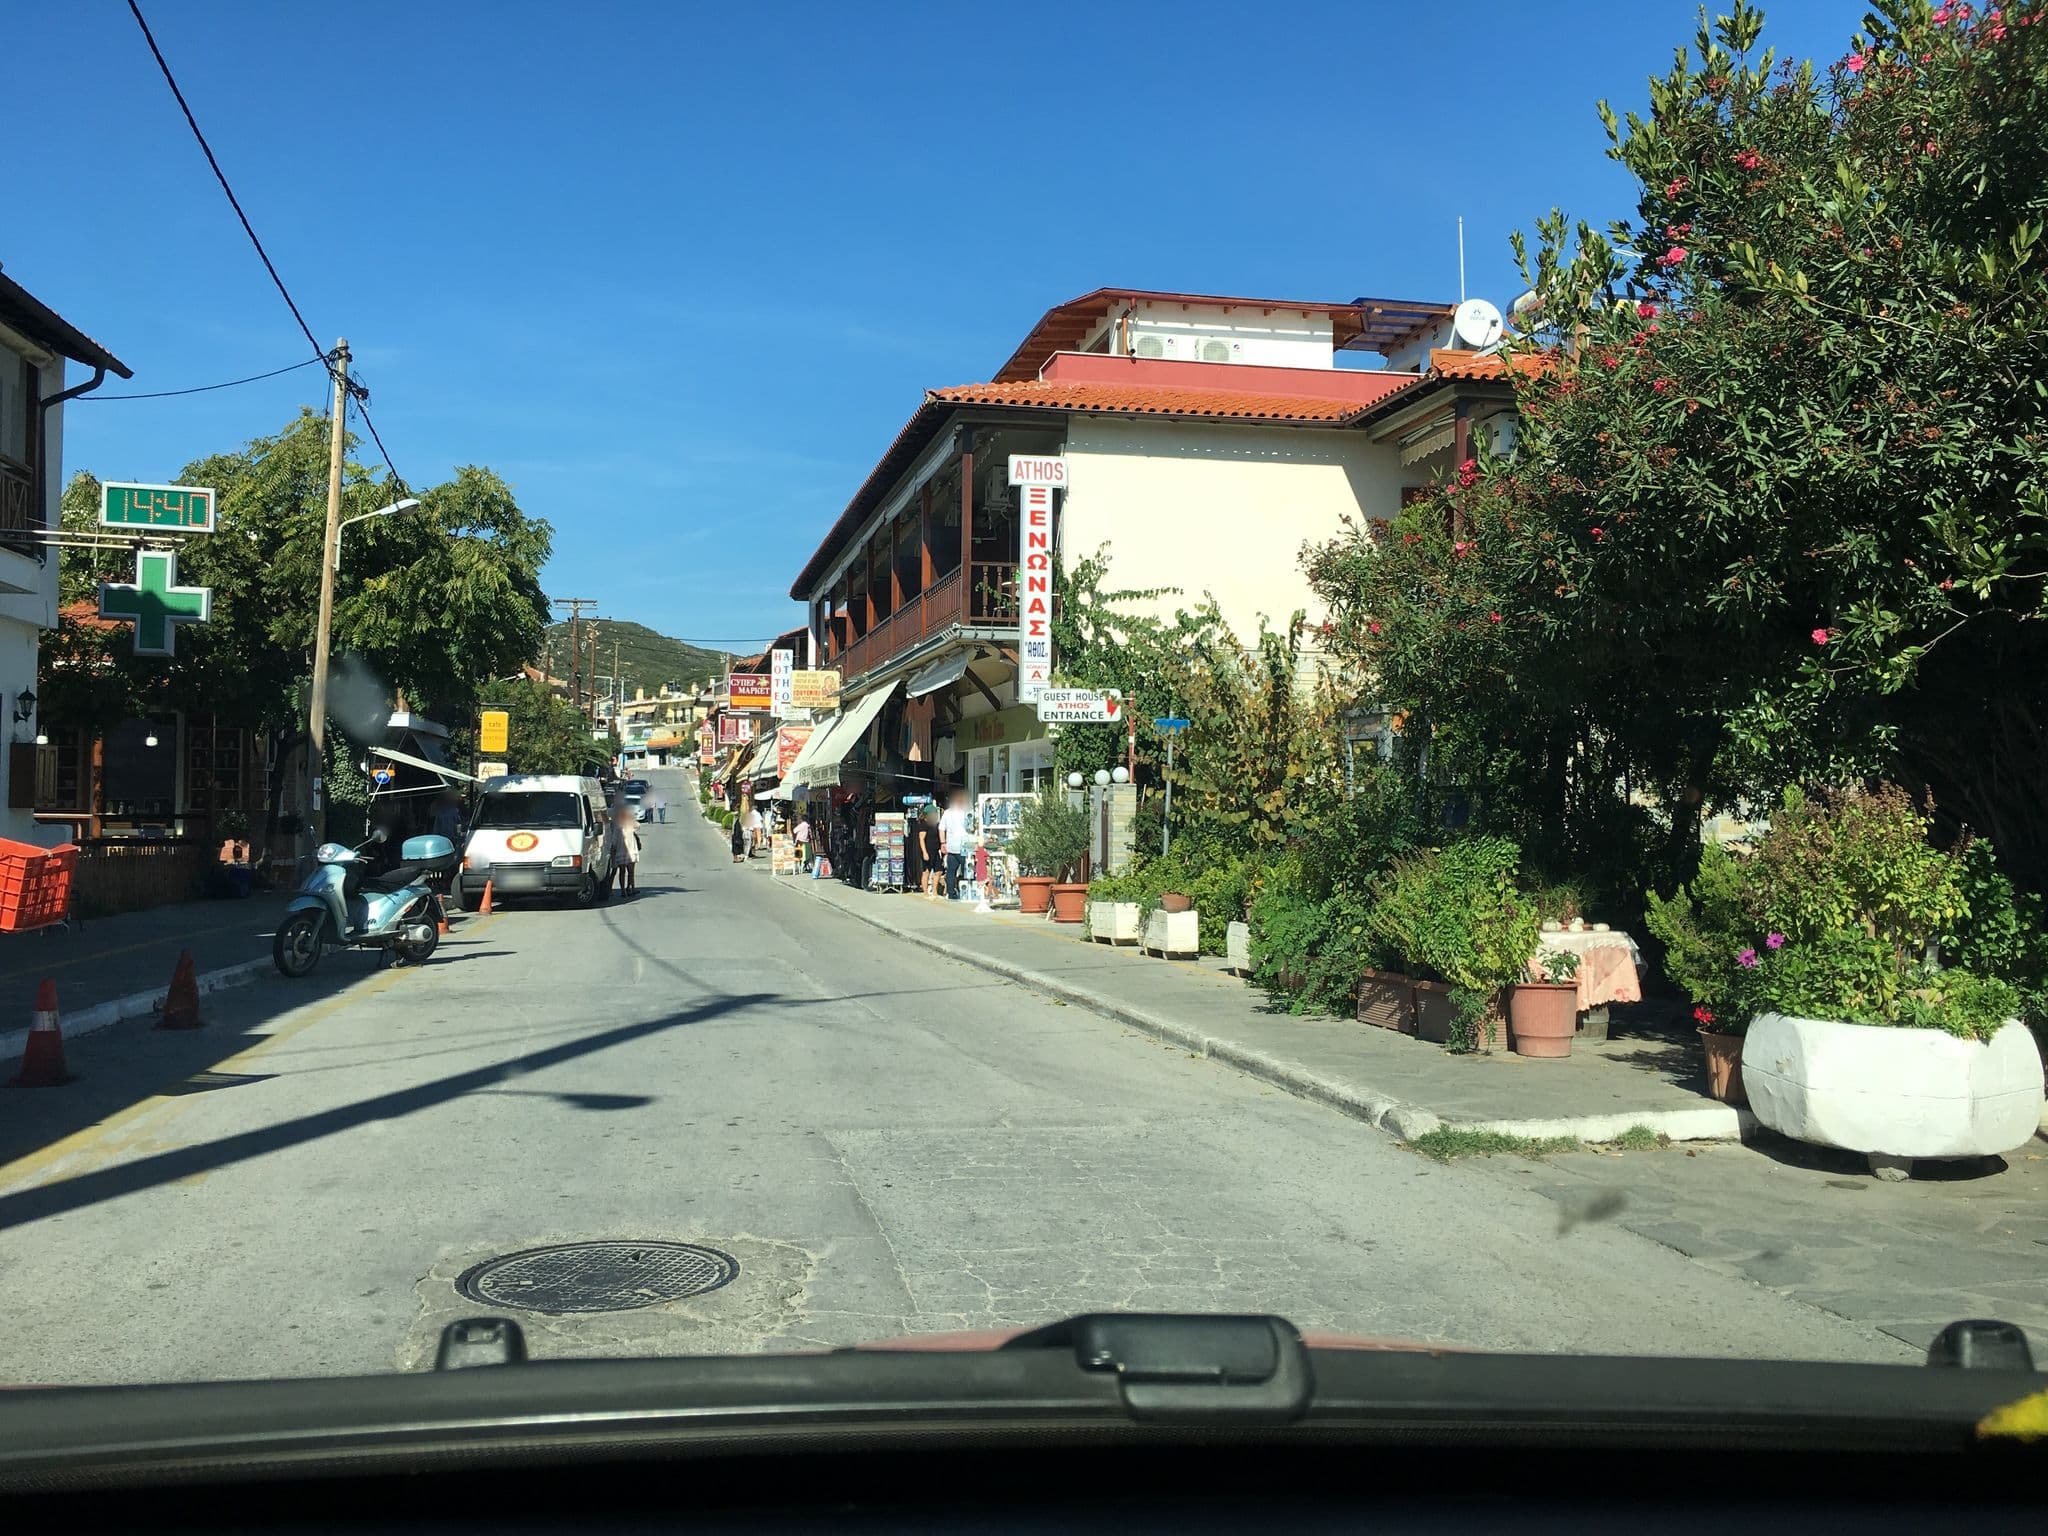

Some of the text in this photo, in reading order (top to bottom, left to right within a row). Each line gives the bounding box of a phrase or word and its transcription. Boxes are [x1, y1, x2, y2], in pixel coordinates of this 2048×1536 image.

[1015, 460, 1064, 481] ATHOS
[123, 489, 210, 528] 14:40
[1027, 487, 1048, 636] ΞΕΝΩΝΑΣ
[730, 679, 756, 687] СУПЕР
[773, 652, 782, 714] HOTEL
[782, 652, 791, 703] ATHO
[738, 687, 771, 695] МАРКЕТ
[1043, 692, 1070, 702] GUEST
[1076, 692, 1104, 702] HOUSE
[1043, 711, 1104, 720] ENTRANCE
